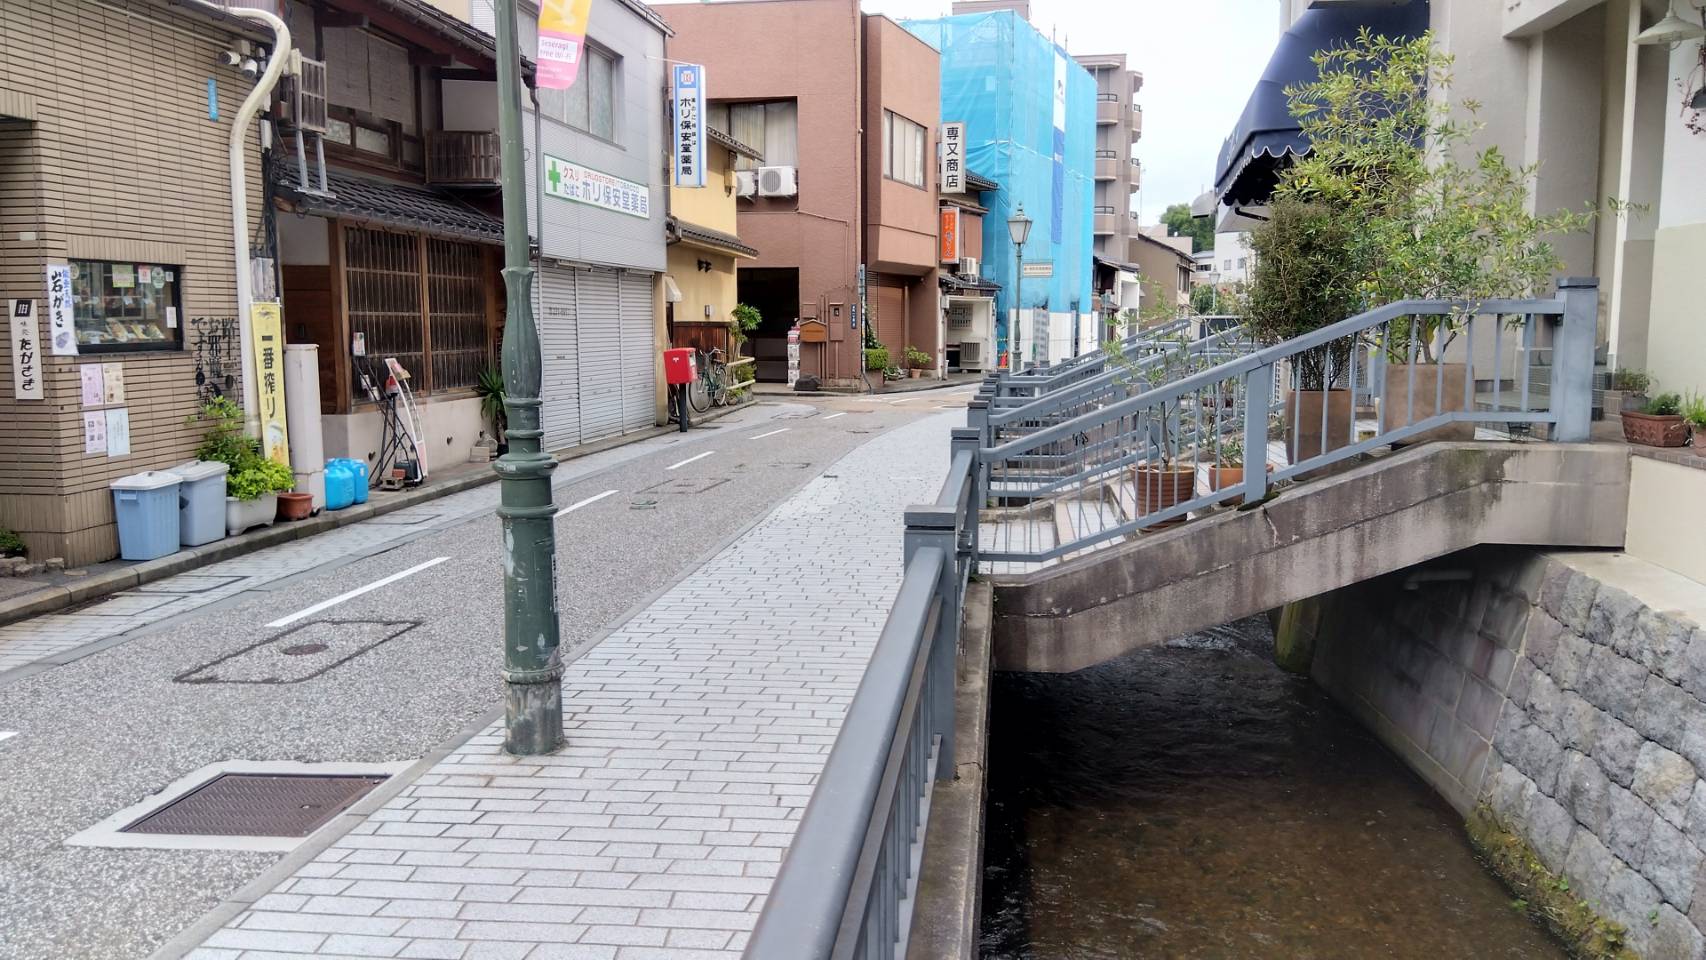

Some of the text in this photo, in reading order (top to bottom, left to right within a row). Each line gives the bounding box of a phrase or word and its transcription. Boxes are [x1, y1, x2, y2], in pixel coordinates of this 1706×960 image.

[680, 97, 693, 176] ホリ保安堂薬局
[946, 126, 959, 188] 専又商店
[563, 166, 580, 182] クスリ
[564, 183, 580, 198] たばこ
[582, 181, 648, 215] ホリ保安堂薬局
[51, 270, 65, 328] 岩がき
[261, 335, 277, 419] 一番搾り
